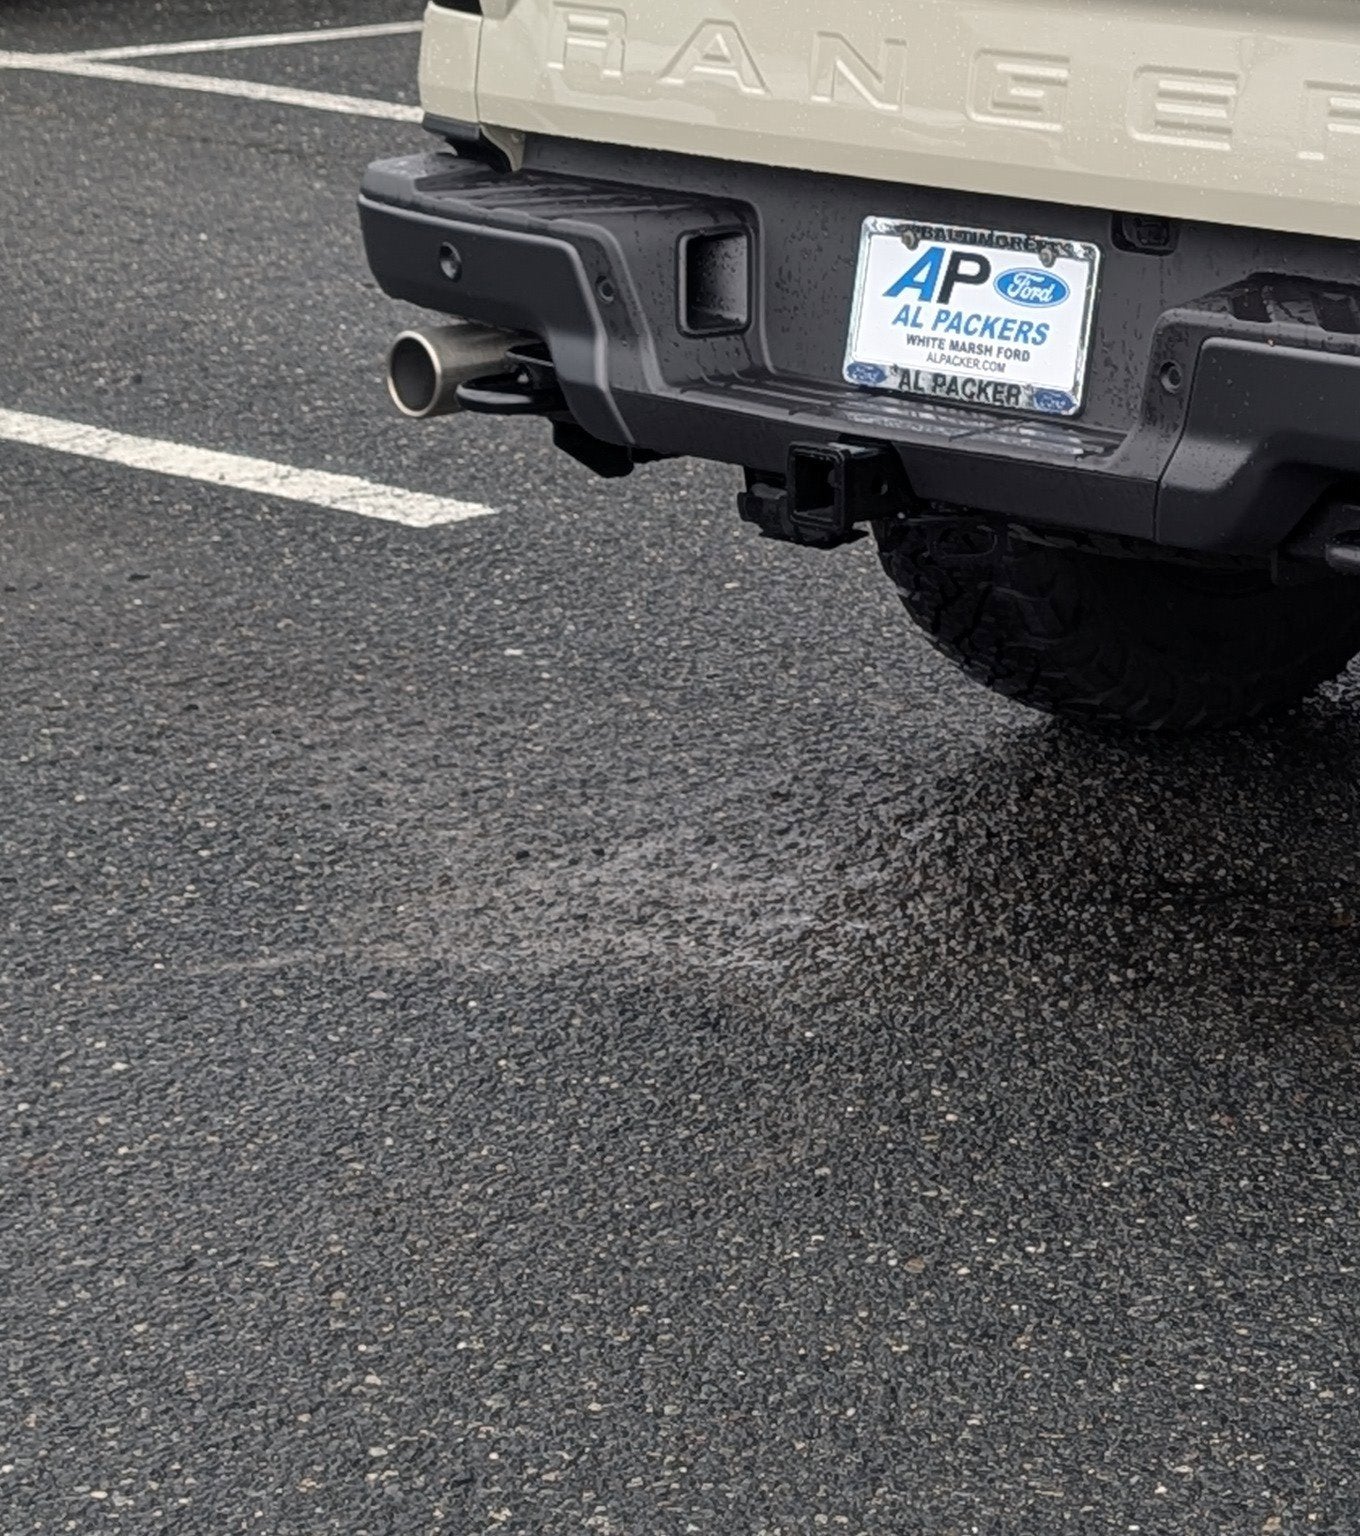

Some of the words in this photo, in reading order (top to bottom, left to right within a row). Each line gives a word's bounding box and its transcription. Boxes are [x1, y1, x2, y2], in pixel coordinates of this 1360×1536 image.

[882, 246, 991, 305] AP
[1005, 270, 1054, 303] Ford
[892, 304, 923, 329] AL
[931, 309, 1050, 346] PACKERS
[906, 333, 946, 351] WHITE
[950, 339, 994, 357] MARSH
[997, 346, 1031, 362] FORD
[926, 353, 1006, 373] ALPACKER.COM
[898, 369, 929, 391] AL
[931, 375, 1022, 407] PACKER
